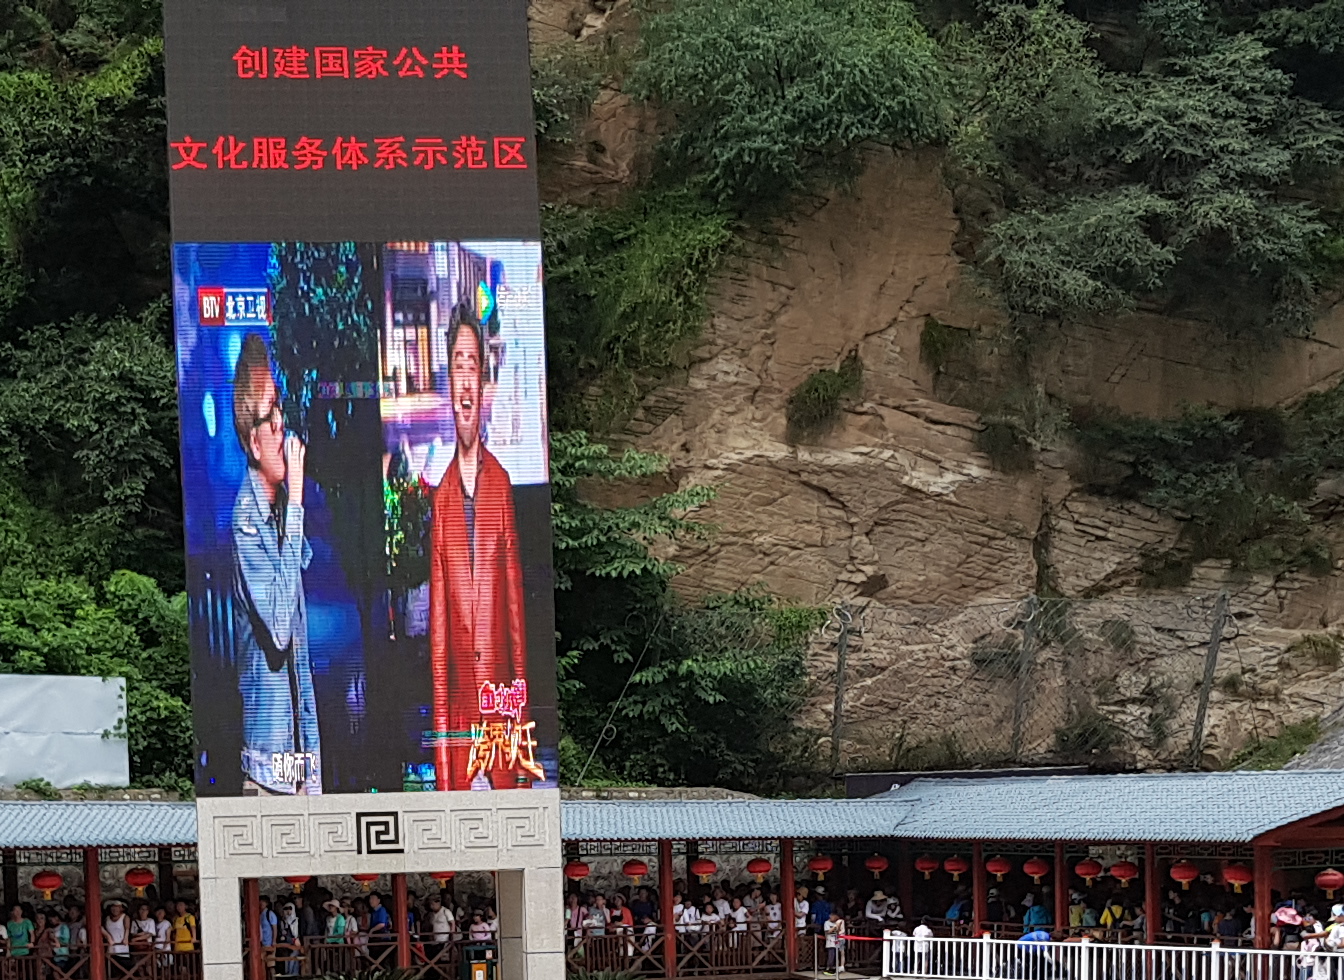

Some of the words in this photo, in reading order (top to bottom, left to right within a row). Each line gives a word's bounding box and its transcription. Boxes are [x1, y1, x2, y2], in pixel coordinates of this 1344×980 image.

[232, 45, 468, 79] 创建国家公共
[169, 134, 528, 170] 文化服务体系示范区
[202, 296, 221, 319] BTV
[225, 294, 267, 320] 北京卫视
